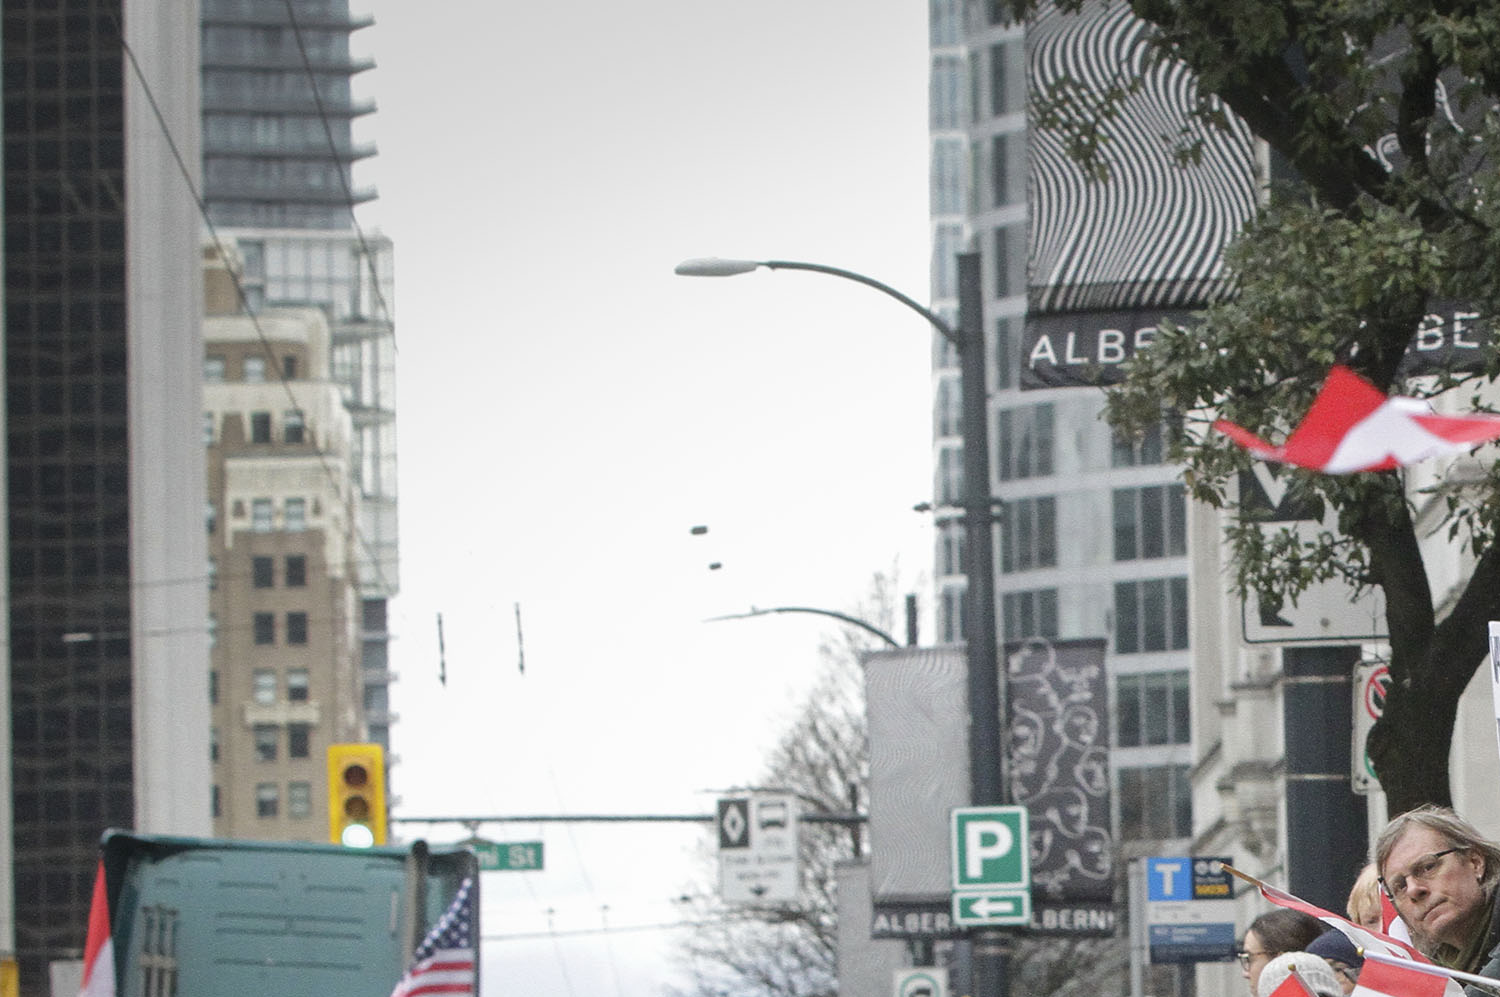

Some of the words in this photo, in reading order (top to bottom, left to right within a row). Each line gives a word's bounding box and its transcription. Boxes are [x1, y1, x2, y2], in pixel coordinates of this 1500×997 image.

[1028, 325, 1190, 370] ALBE
[965, 820, 1013, 879] P
[1155, 863, 1181, 896] T
[1030, 908, 1115, 930] LBERNI
